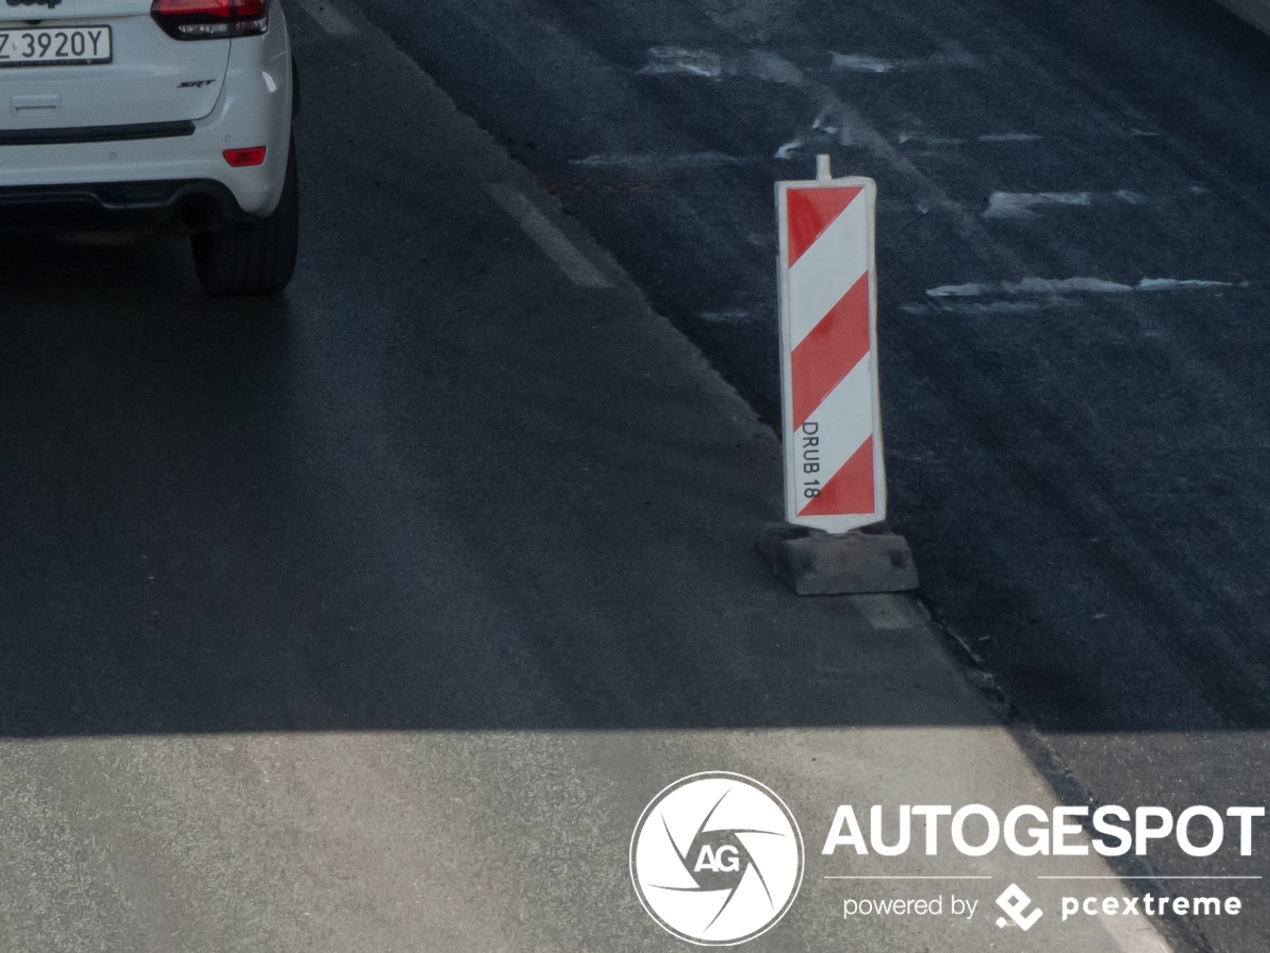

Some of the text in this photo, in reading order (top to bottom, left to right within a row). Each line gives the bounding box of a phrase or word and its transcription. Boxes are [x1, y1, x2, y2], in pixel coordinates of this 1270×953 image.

[21, 30, 102, 58] 3920Y
[801, 421, 821, 499] DRUB 18
